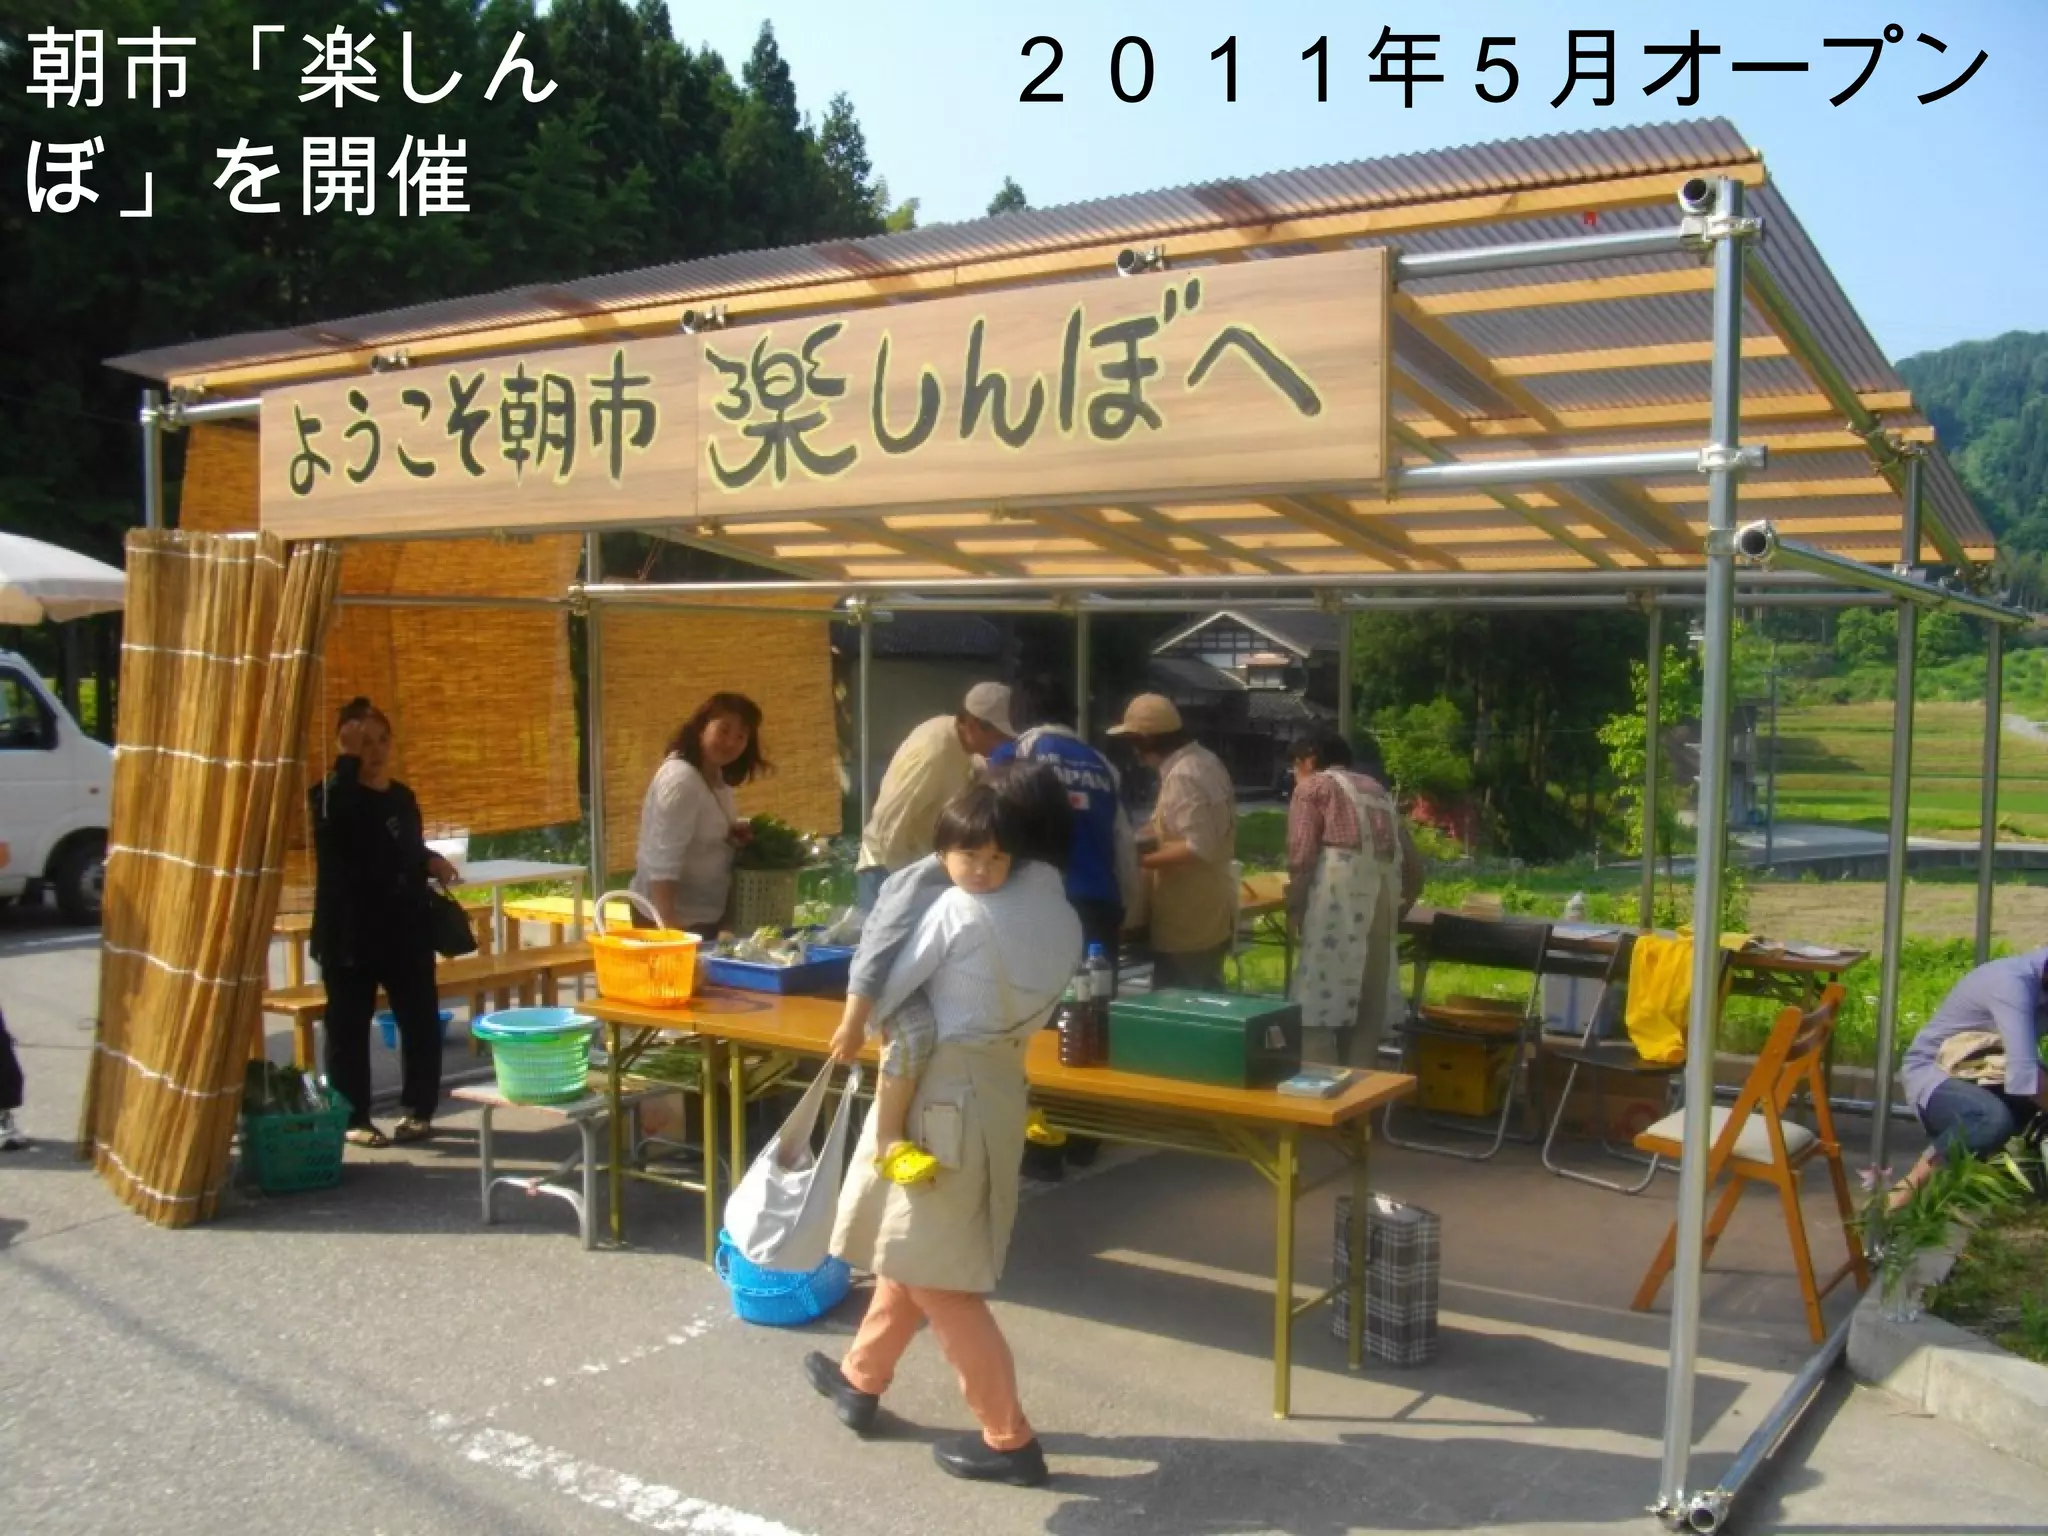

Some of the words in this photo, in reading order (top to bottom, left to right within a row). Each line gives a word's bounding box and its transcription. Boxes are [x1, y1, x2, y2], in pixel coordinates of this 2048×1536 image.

[288, 348, 657, 496] ようこそ朝市
[705, 278, 1322, 489] 楽しんぼへ
